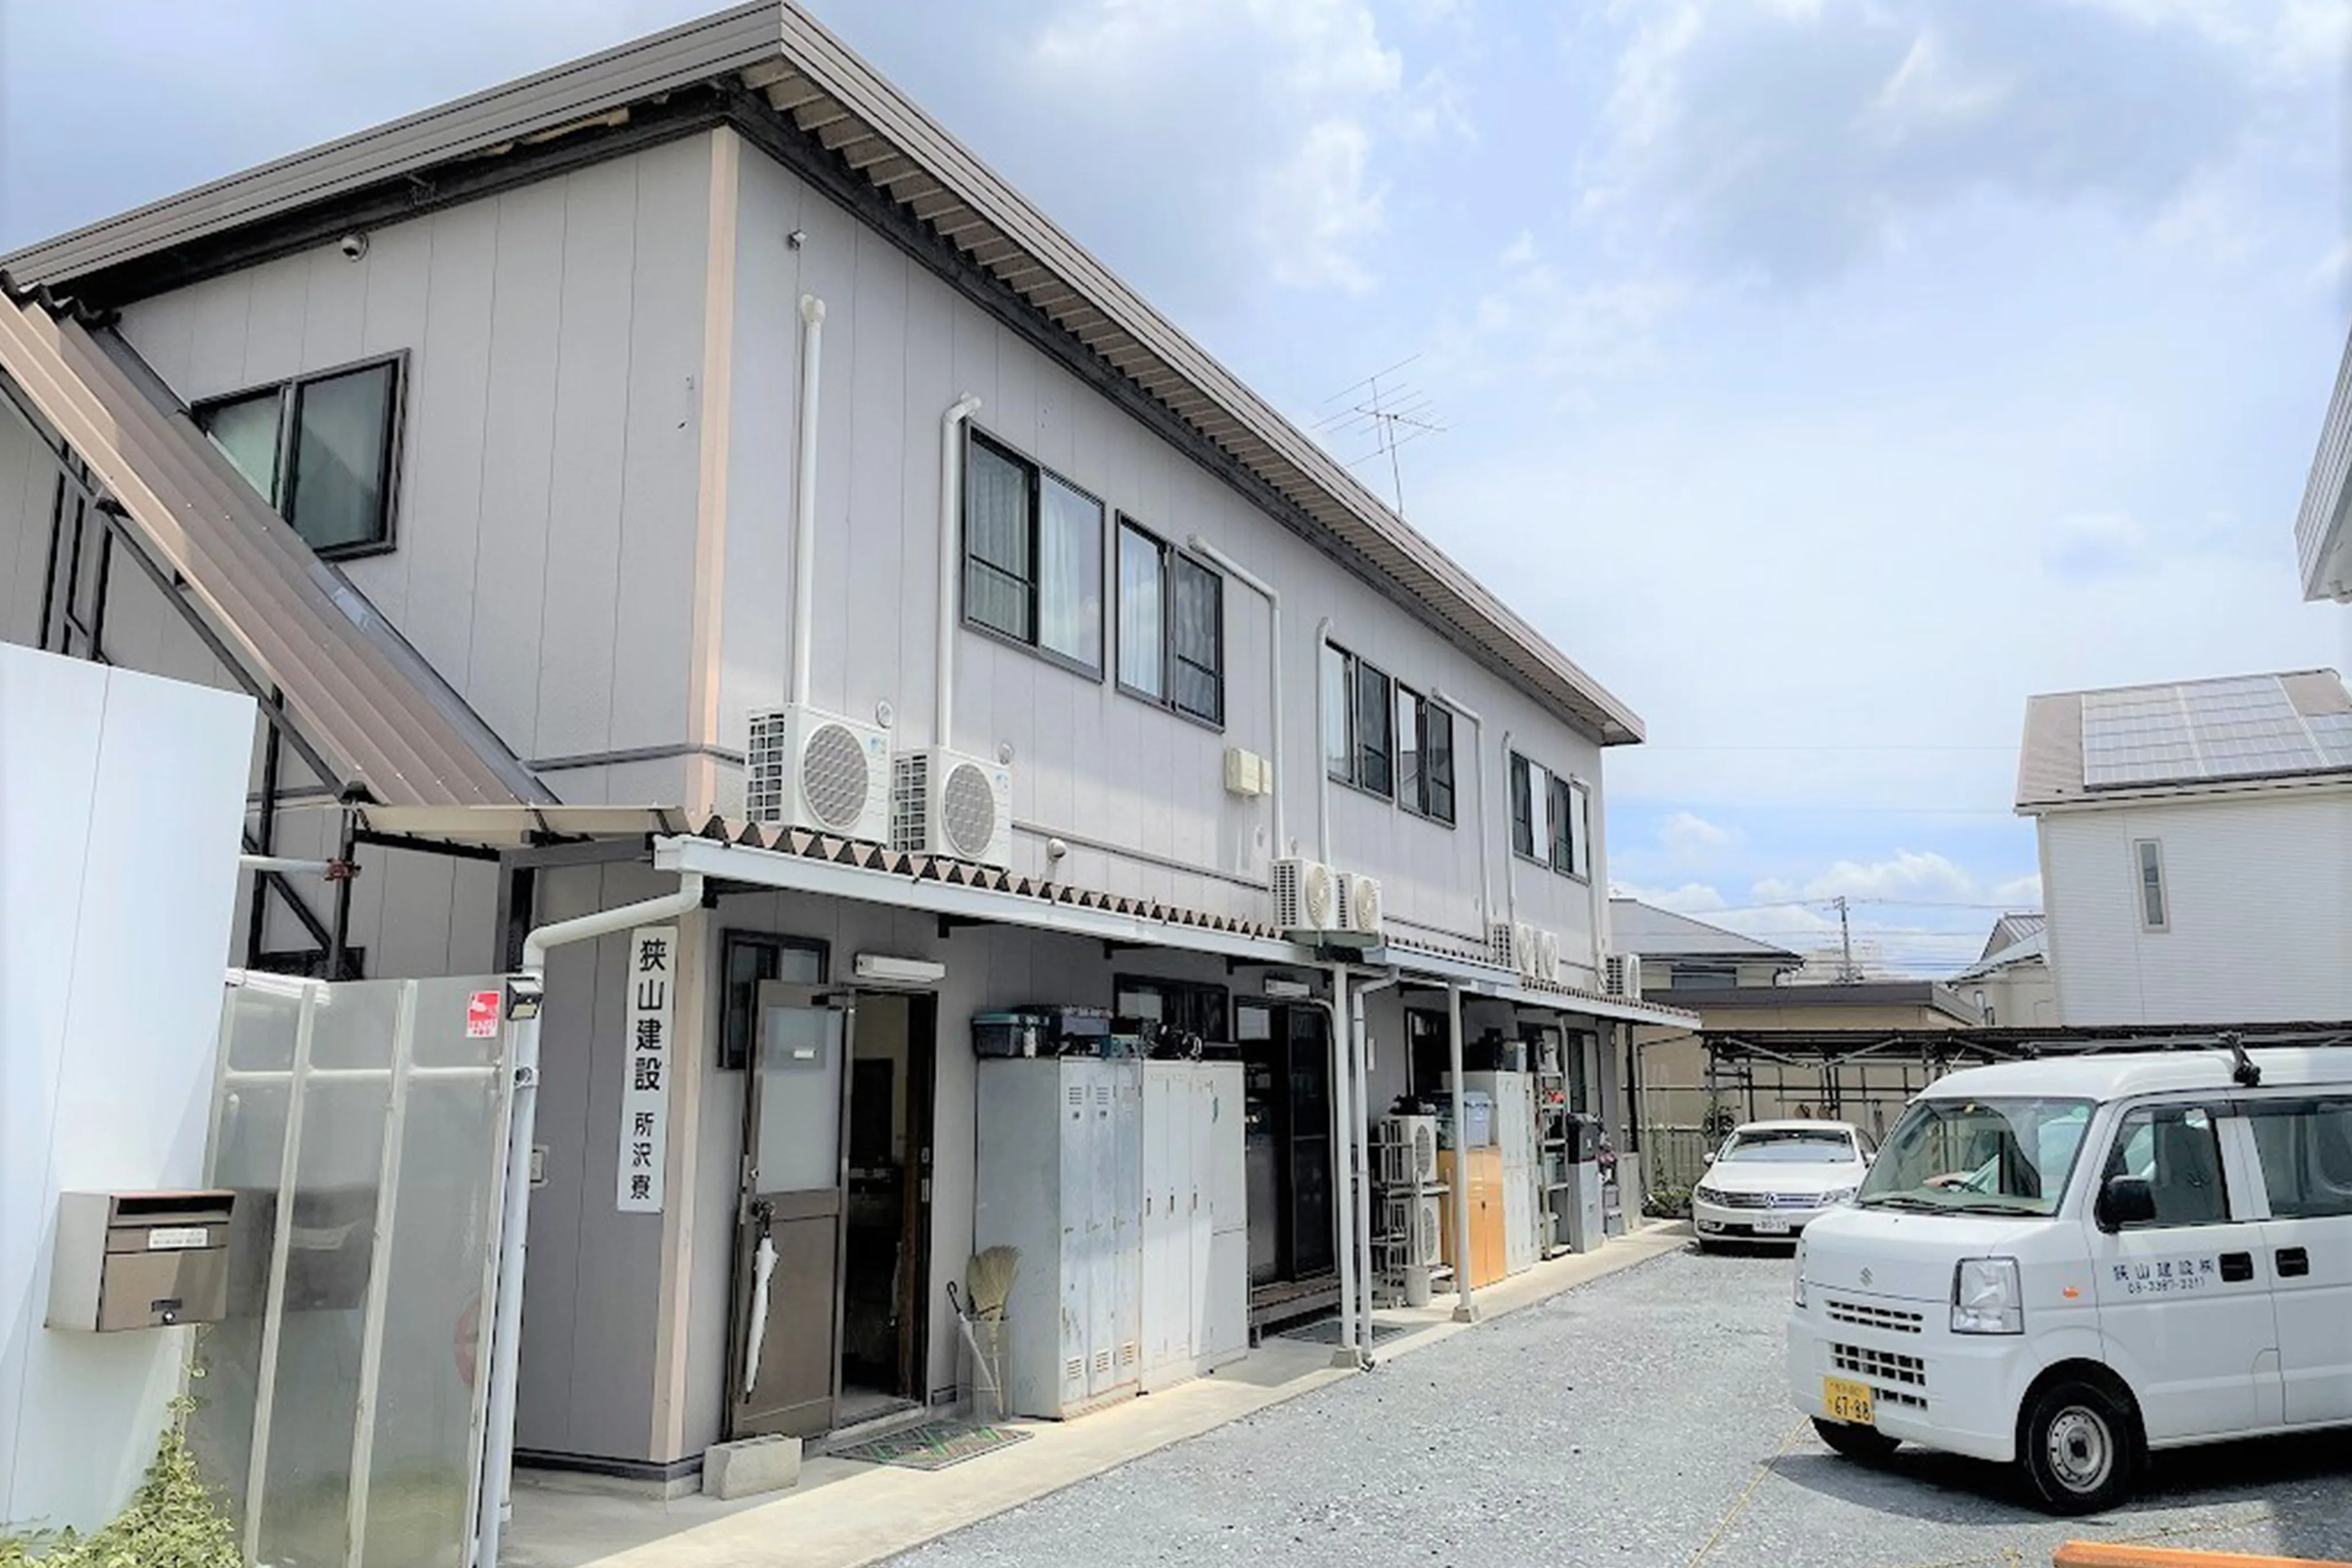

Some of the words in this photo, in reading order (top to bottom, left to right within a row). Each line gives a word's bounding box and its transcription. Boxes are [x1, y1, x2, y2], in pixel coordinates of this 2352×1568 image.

[634, 938, 667, 1091] 狭山建設
[630, 1112, 655, 1200] 所沢寮
